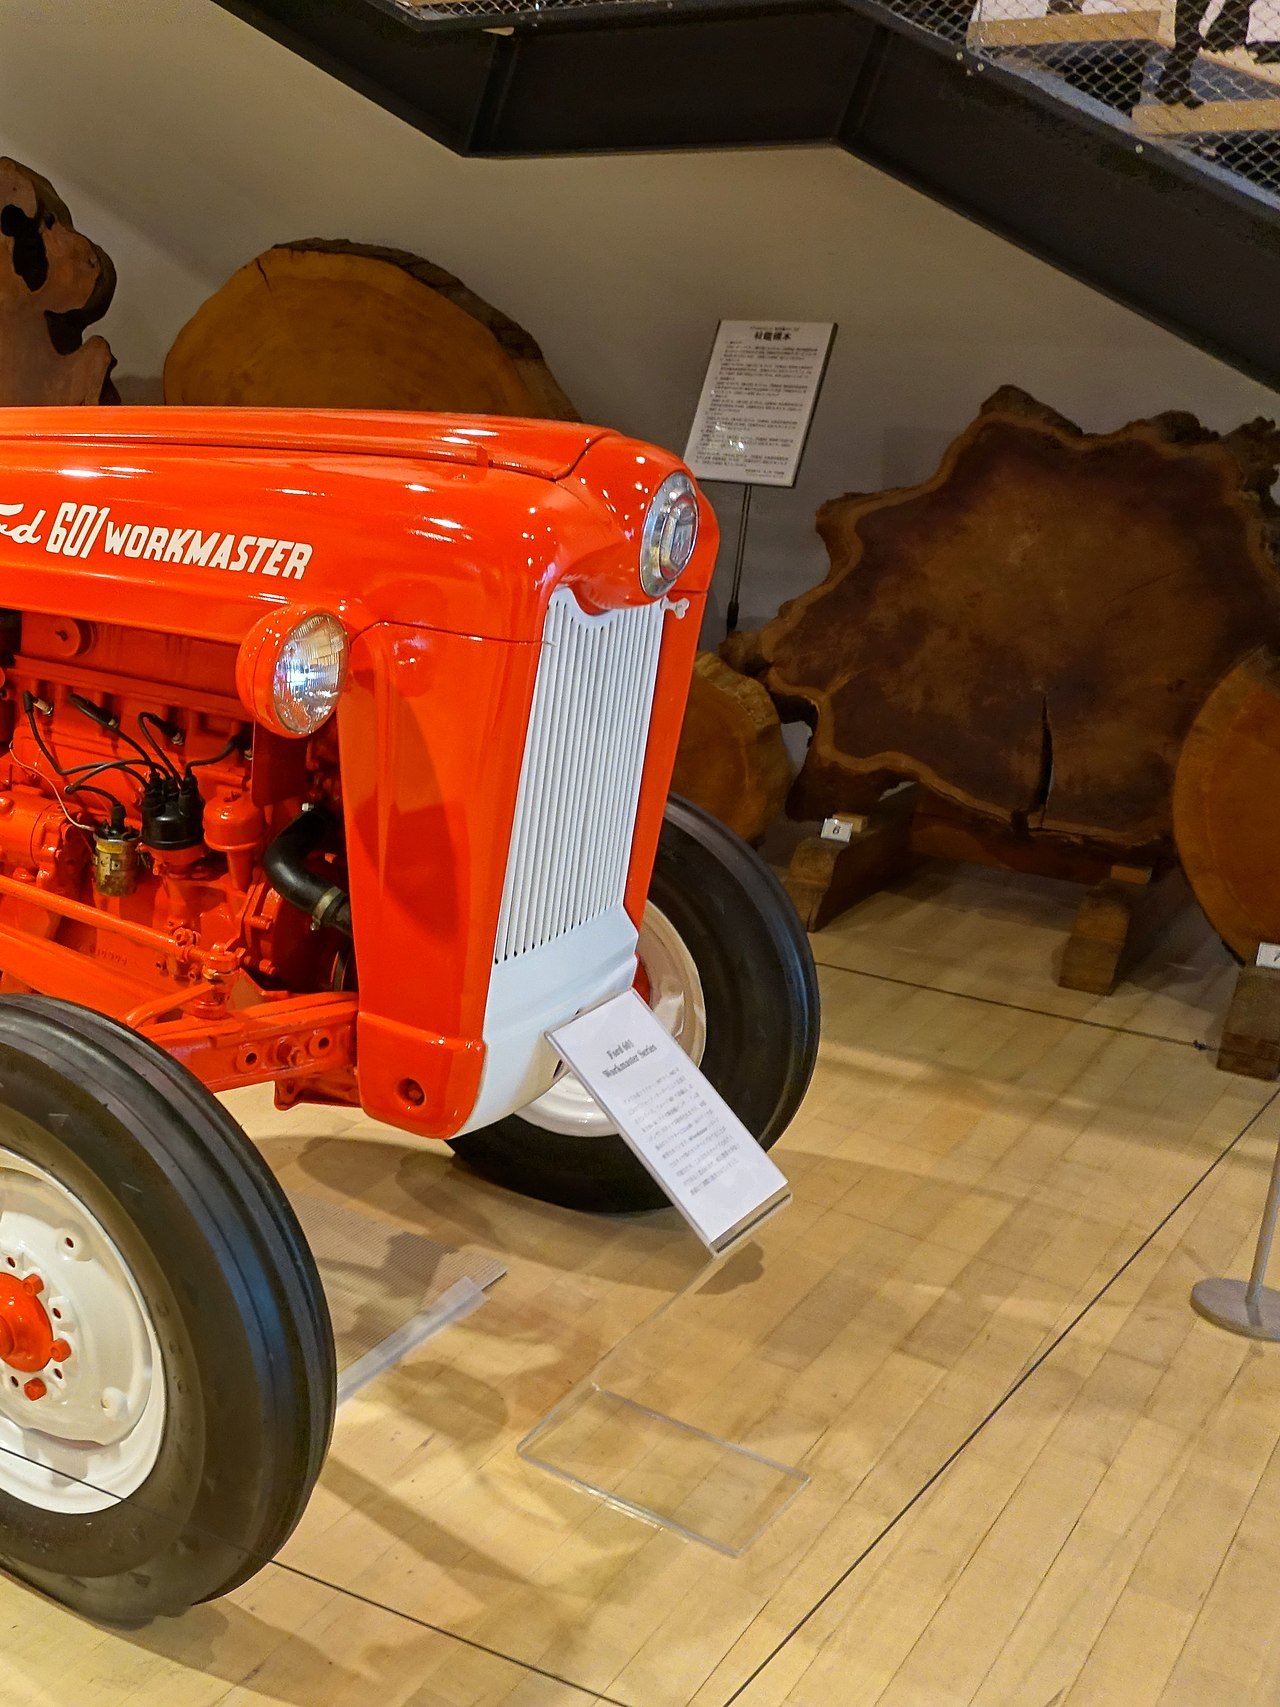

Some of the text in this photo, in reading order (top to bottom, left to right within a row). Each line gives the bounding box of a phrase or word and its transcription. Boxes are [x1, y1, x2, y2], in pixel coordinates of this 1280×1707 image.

[45, 502, 110, 559] 601
[105, 519, 313, 580] WORKMASTER
[602, 1044, 658, 1078] Workmaster Series
[606, 1039, 635, 1060] Ford 601
